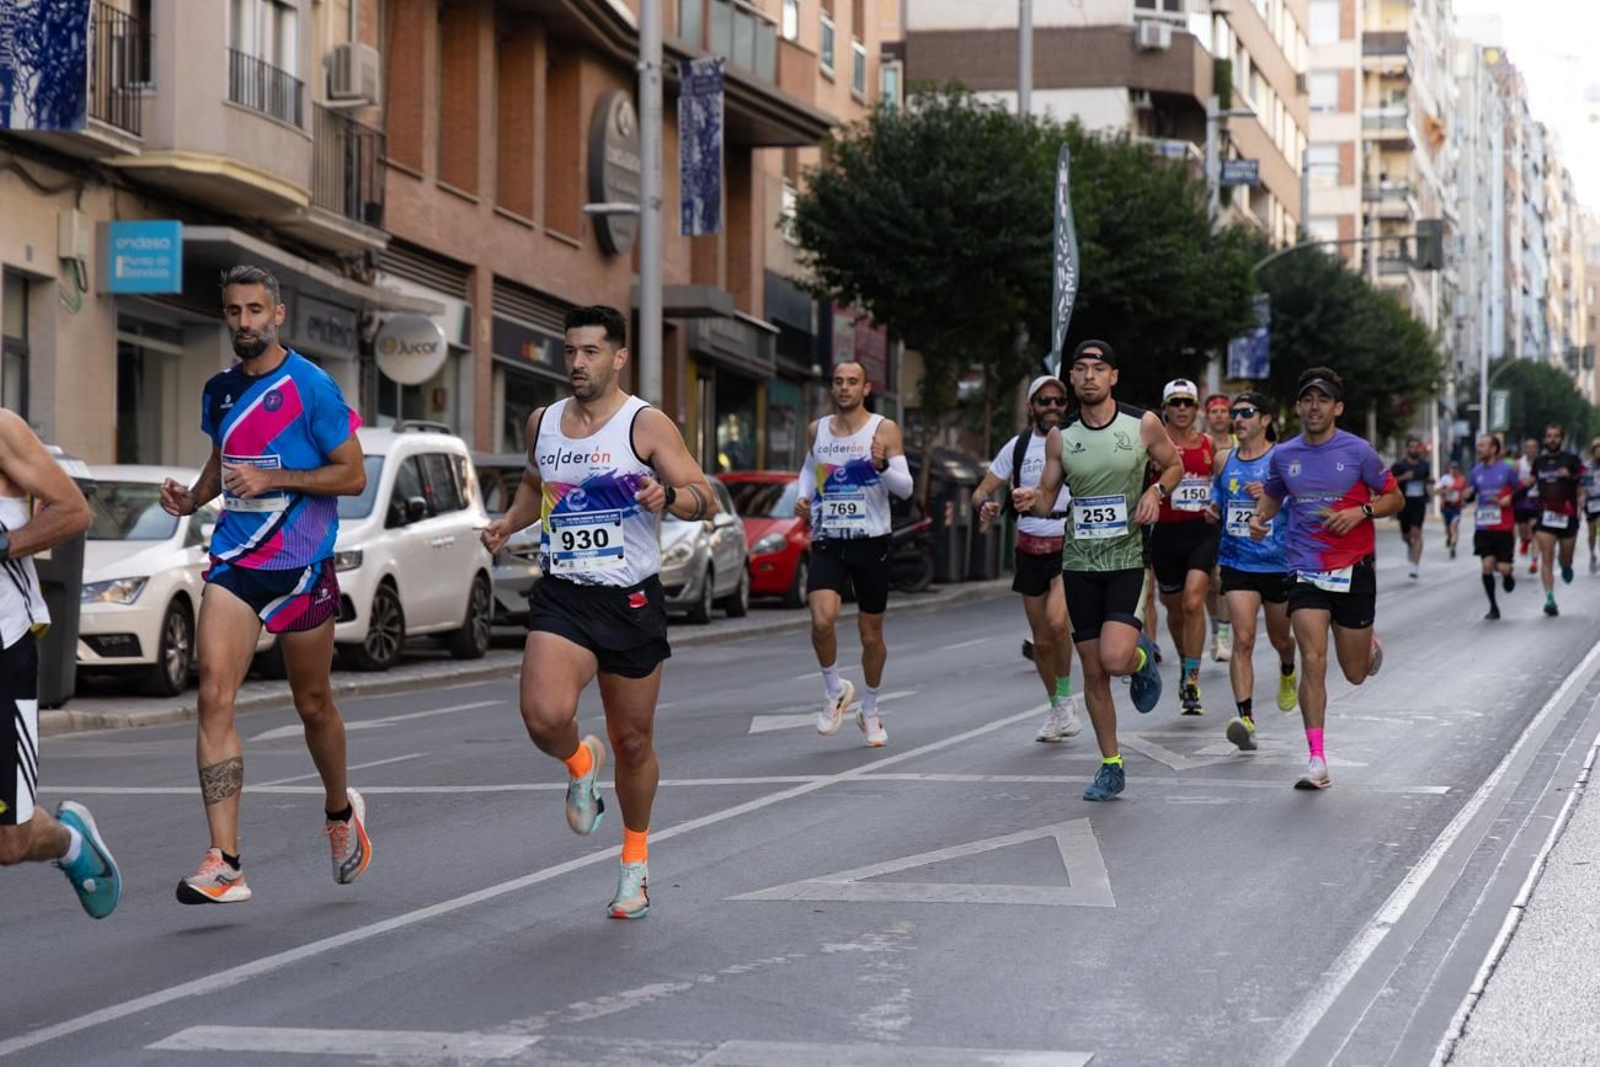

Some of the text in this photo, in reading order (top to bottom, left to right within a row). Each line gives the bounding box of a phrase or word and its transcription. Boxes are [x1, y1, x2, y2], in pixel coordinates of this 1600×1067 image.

[540, 446, 611, 471] calderón
[1181, 488, 1206, 500] 150
[829, 502, 857, 515] 769
[1082, 507, 1117, 523] 253
[561, 528, 609, 551] 930
